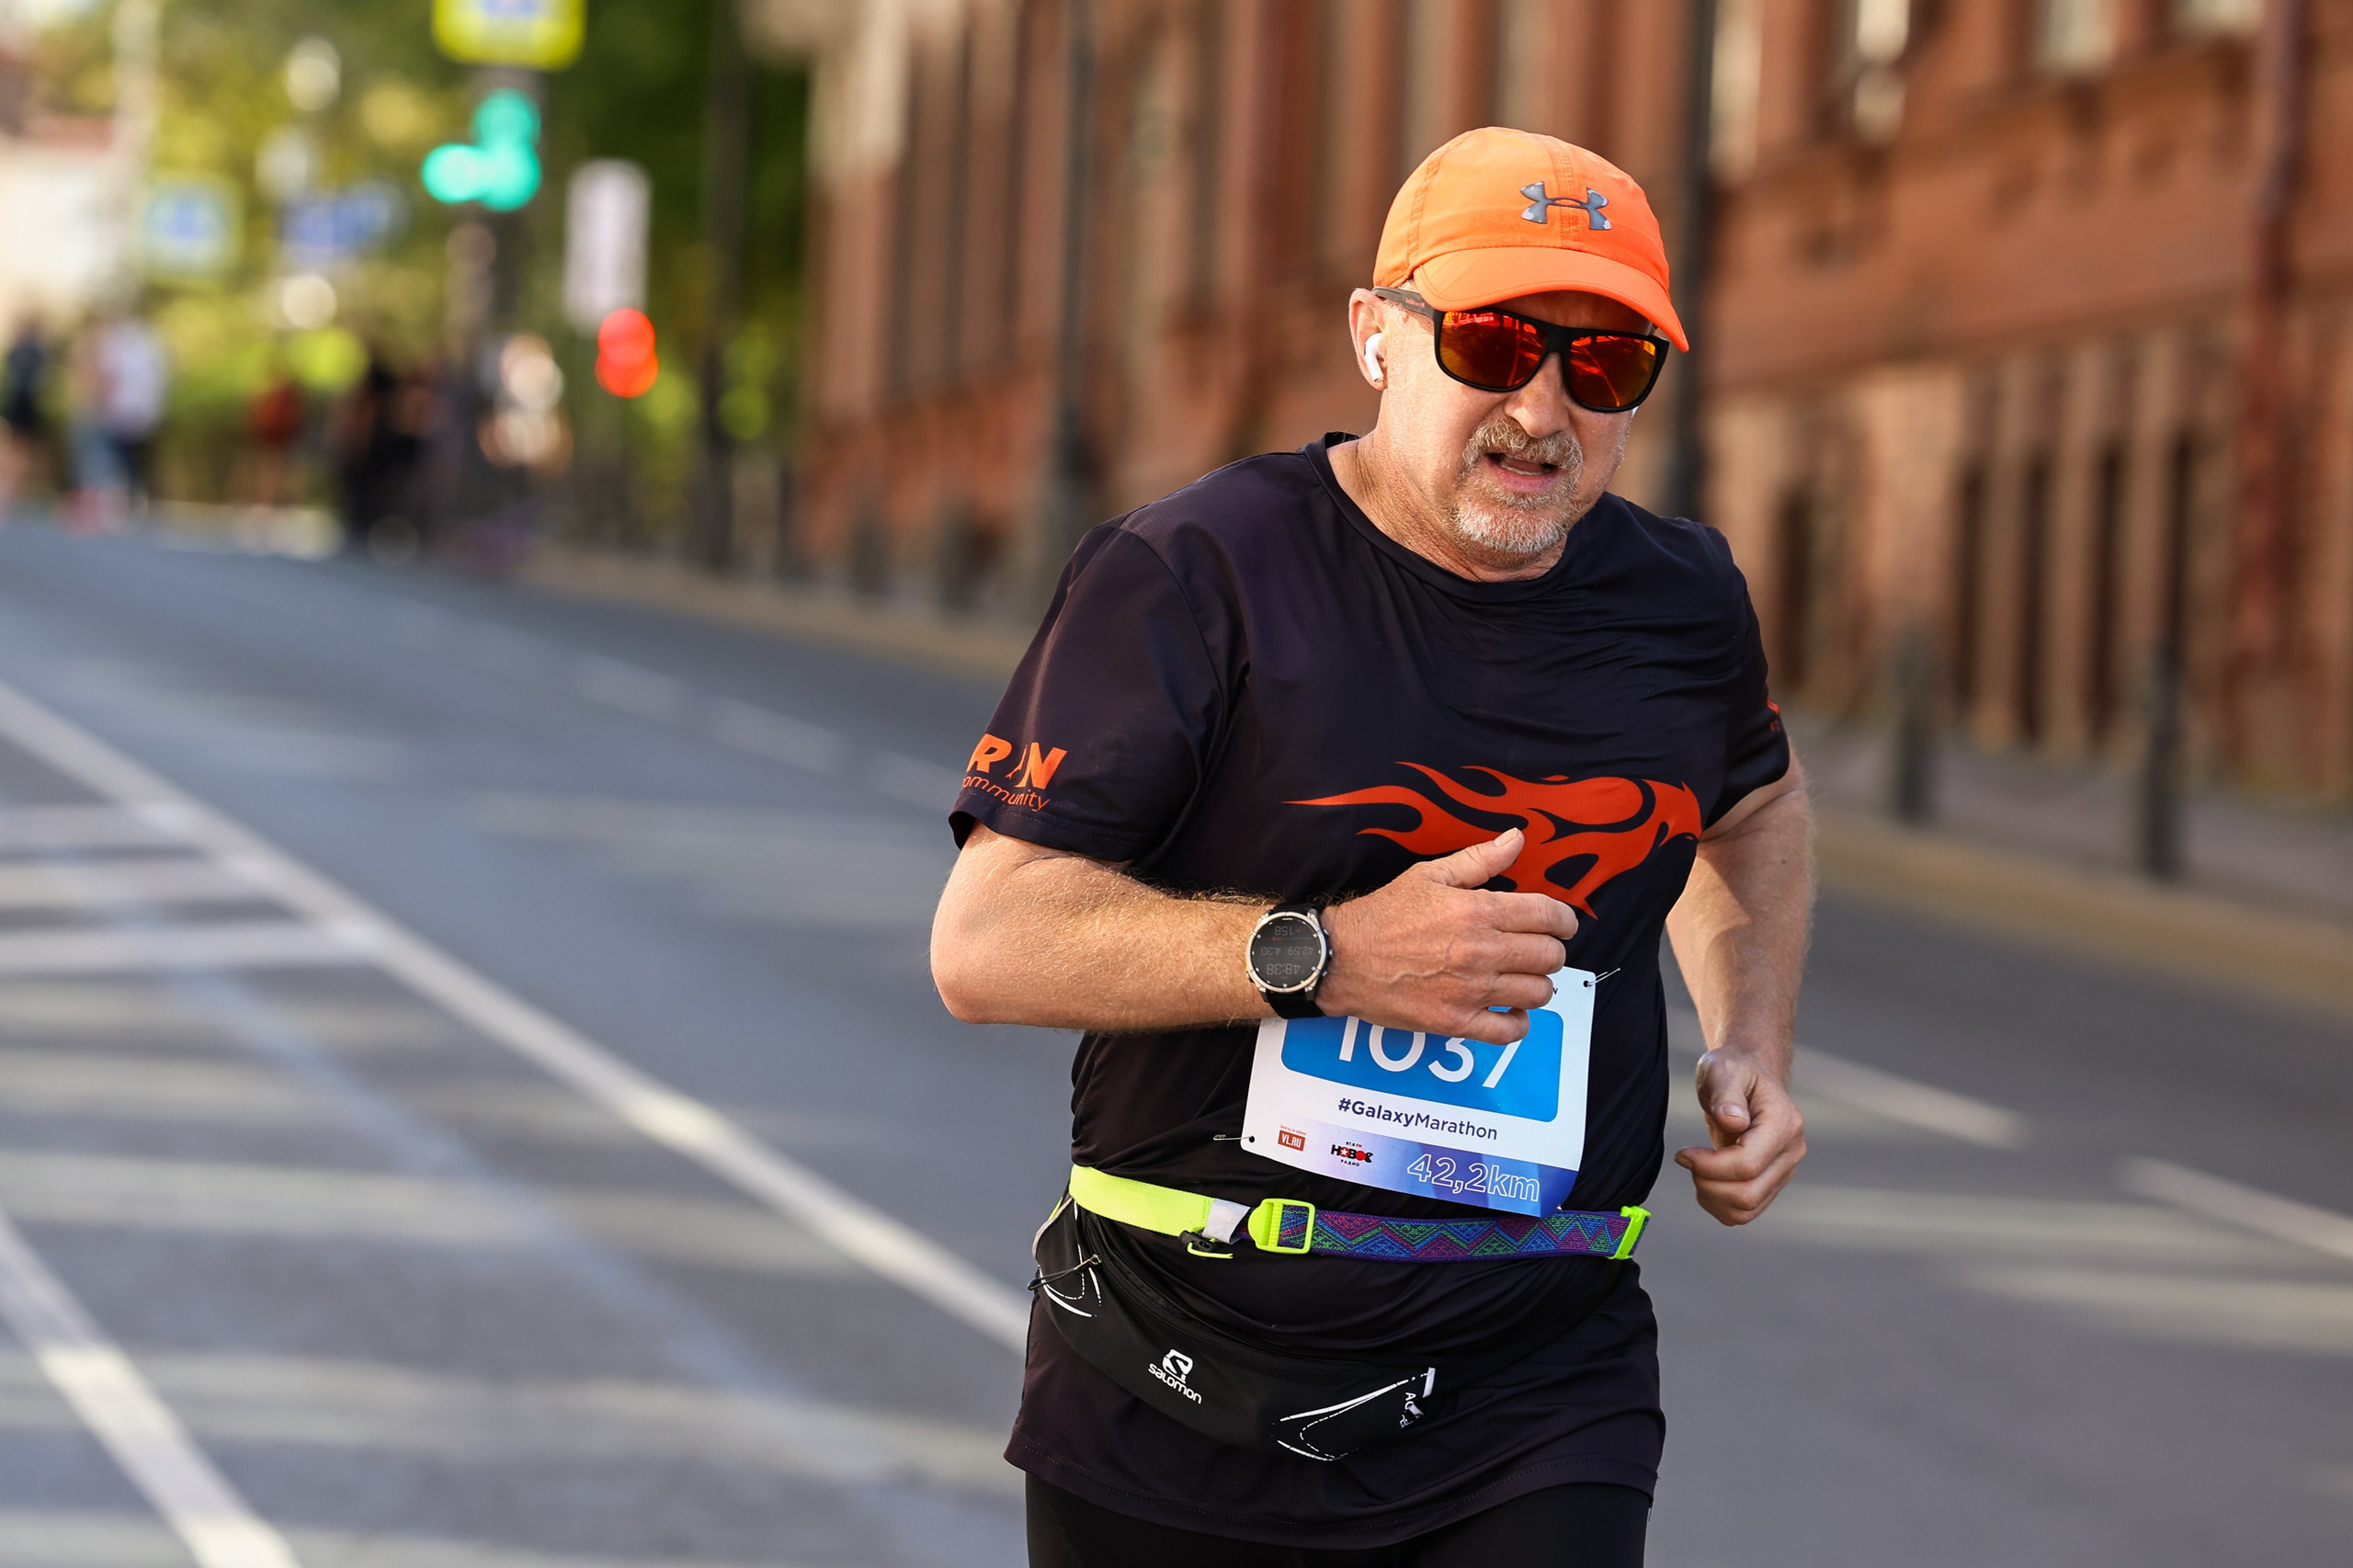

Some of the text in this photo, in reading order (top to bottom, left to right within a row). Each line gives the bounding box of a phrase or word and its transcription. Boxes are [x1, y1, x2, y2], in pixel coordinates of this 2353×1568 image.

[962, 775, 1051, 812] ommunity
[1339, 1016, 1523, 1088] 1037
[1337, 1097, 1498, 1141] #GalaxyMarathon
[1281, 1132, 1302, 1149] VL.RU
[1340, 1159, 1360, 1167] РАДИО
[1407, 1153, 1540, 1202] 42,2km
